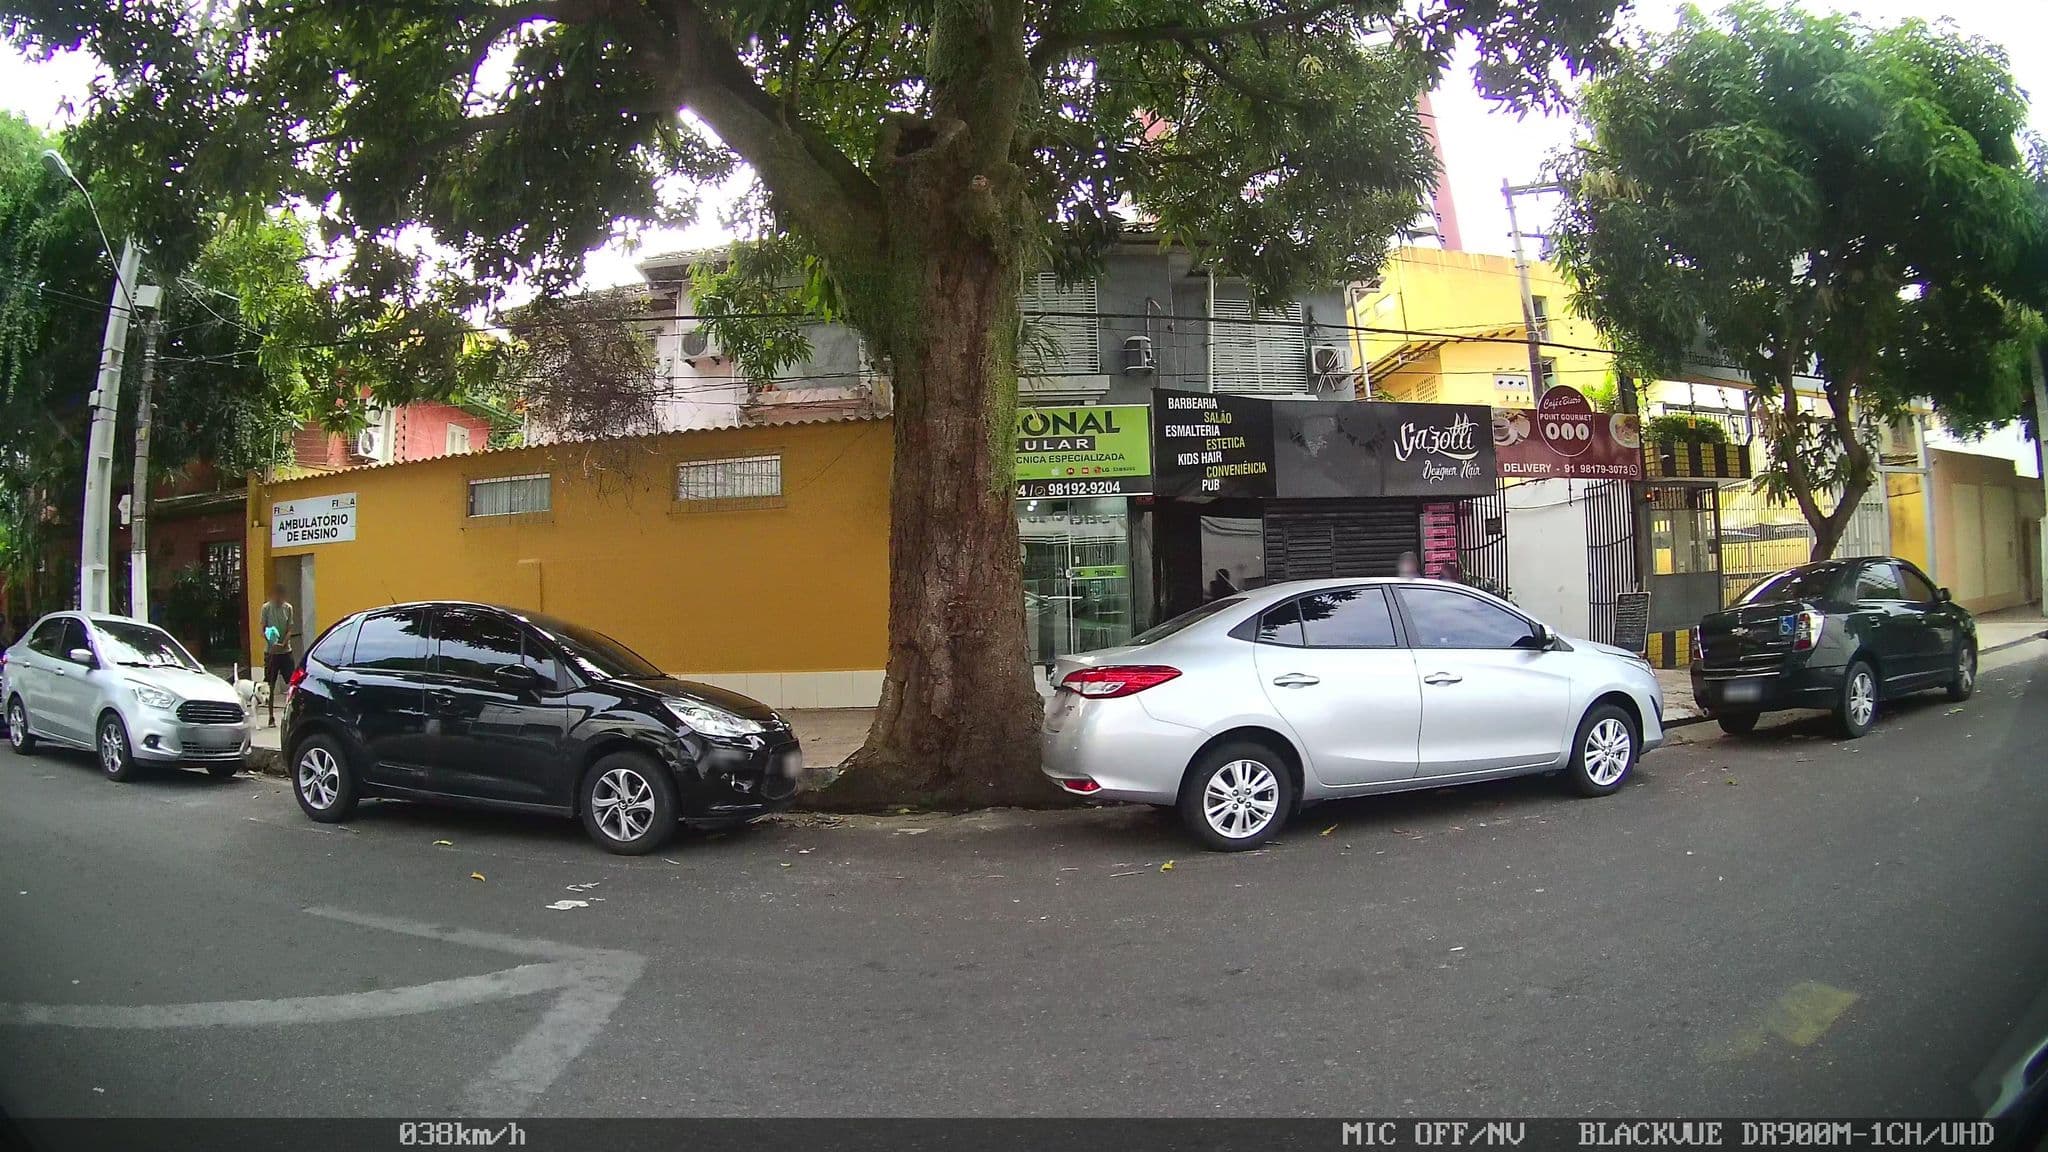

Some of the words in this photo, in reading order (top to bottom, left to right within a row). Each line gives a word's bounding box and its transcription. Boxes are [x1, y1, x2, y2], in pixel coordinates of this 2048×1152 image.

[1168, 397, 1218, 410] BARBEARIA
[1016, 410, 1121, 437] ONAL
[1539, 413, 1560, 421] POINT
[1560, 413, 1592, 421] GOURMET
[1165, 424, 1220, 437] ESMALTERIA
[1016, 438, 1090, 452] ULAR
[1048, 453, 1126, 464] ESPECIALIZADA
[1177, 452, 1199, 466] KIDS
[1201, 450, 1223, 464] HAIR
[1504, 463, 1551, 473] DELIVERY
[1564, 464, 1575, 473] 91
[1580, 464, 1628, 475] 98179-3073
[1048, 481, 1121, 496] 98192-9204
[1202, 479, 1220, 492] PUB
[287, 531, 299, 542] DE
[301, 528, 338, 541] ENSINO
